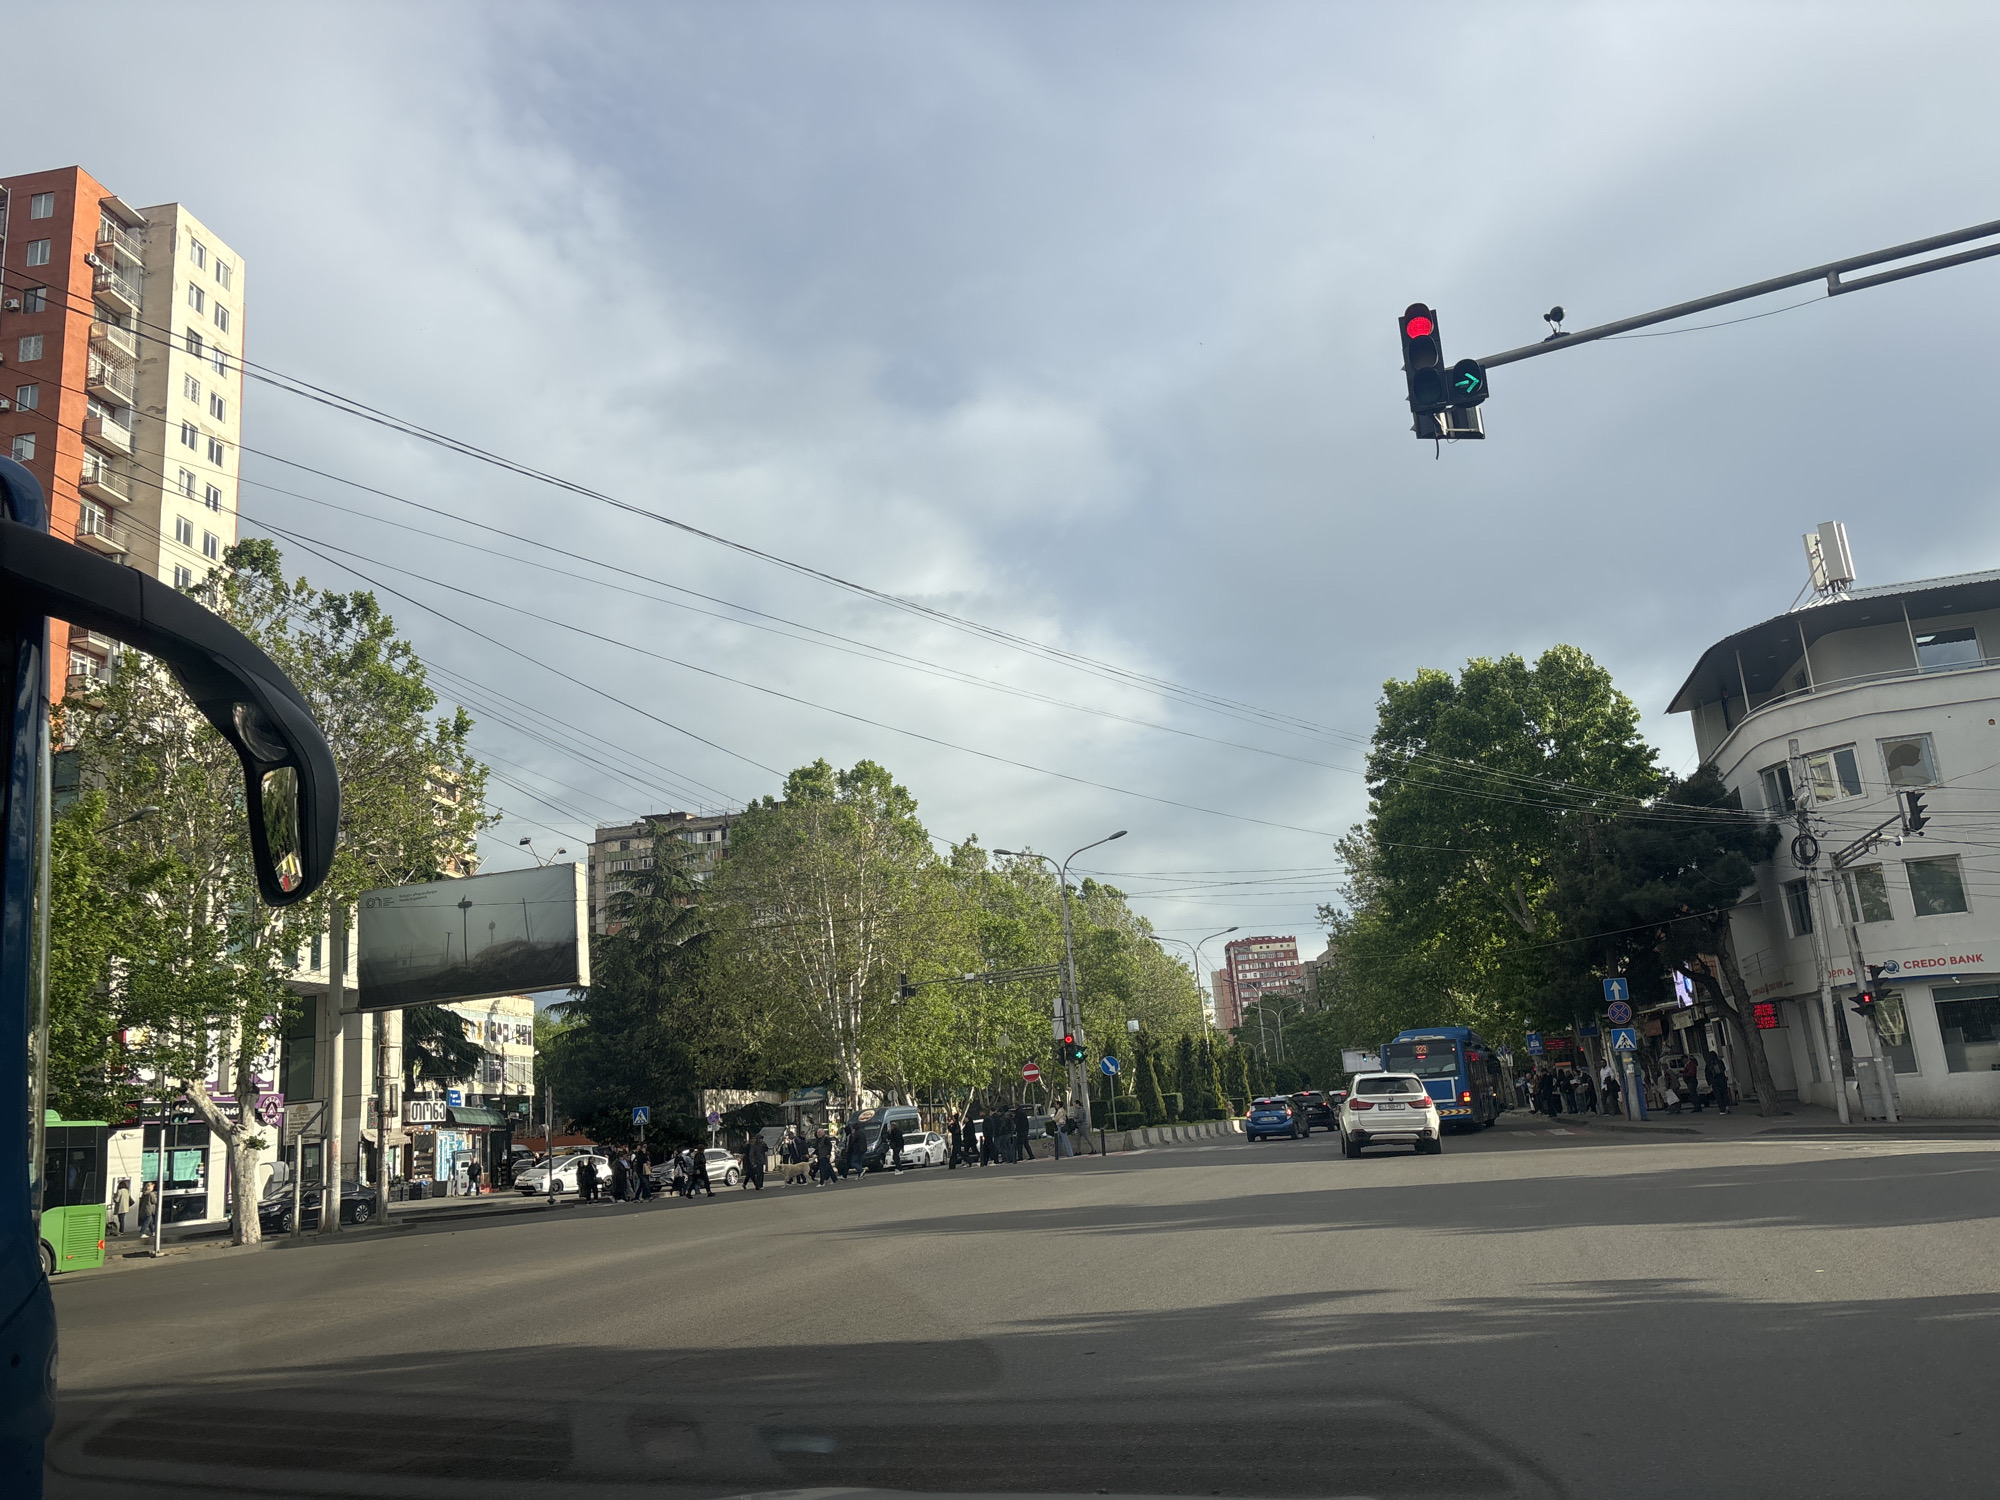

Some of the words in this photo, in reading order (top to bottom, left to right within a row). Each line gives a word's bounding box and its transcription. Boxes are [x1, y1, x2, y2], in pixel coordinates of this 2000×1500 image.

[1903, 957, 1946, 970] CREDO
[1949, 953, 1984, 965] BANK
[1415, 1044, 1427, 1054] 323
[411, 1102, 446, 1121] თონე
